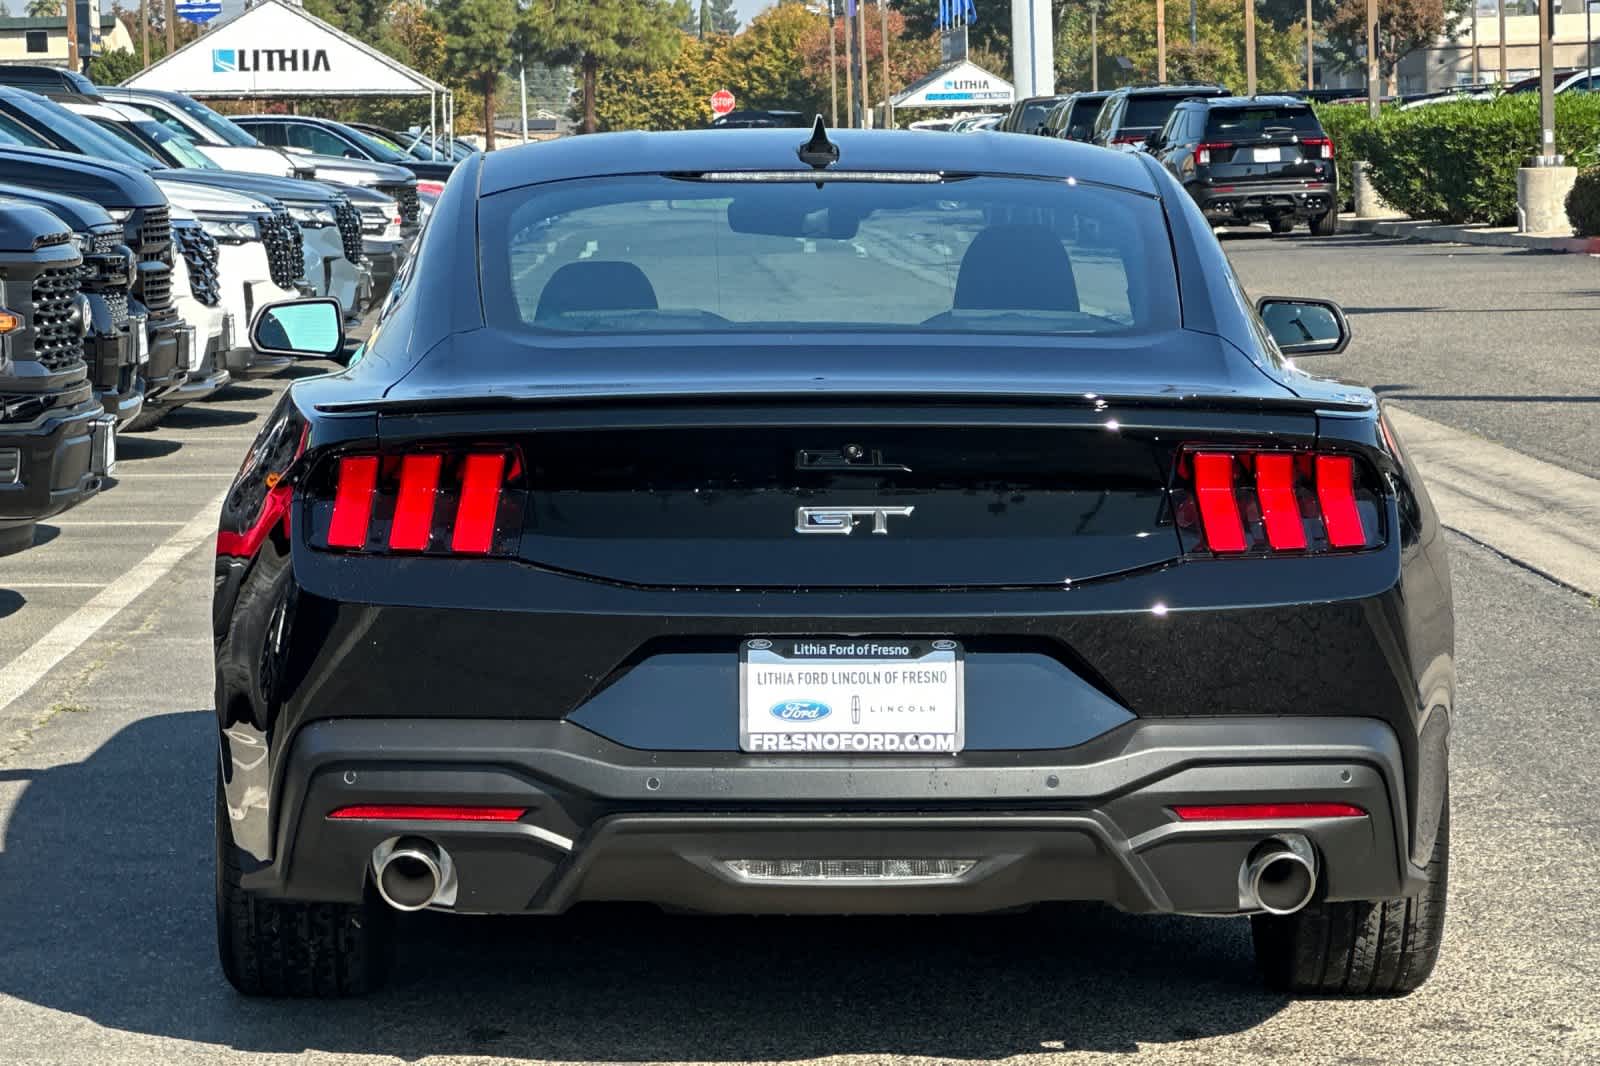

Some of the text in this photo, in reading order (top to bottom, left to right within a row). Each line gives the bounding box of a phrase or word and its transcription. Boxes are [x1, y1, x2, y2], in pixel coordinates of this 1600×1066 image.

[238, 48, 331, 72] LITHIA
[953, 80, 990, 89] LITHIA
[712, 97, 734, 107] STOP
[796, 506, 915, 534] GT
[794, 643, 909, 655] Lithia Ford of Fresno
[757, 670, 947, 685] LITHIA FORD LINCOLN OF FRESNO
[782, 703, 820, 719] Ford
[870, 705, 936, 713] LINCOLN
[749, 734, 955, 750] FRESNOFORD.COM
